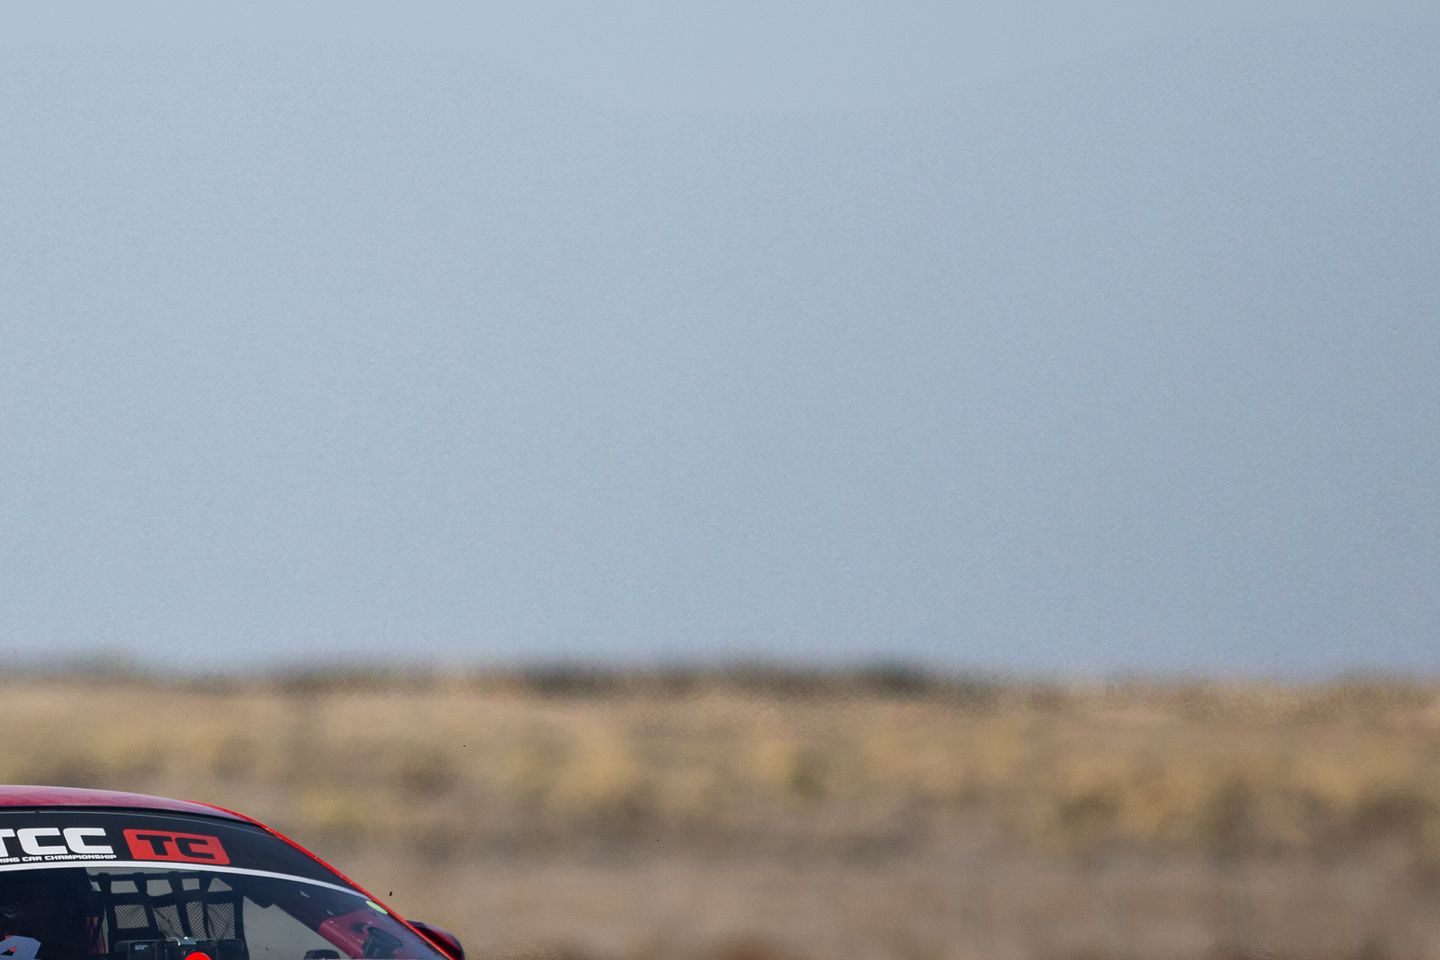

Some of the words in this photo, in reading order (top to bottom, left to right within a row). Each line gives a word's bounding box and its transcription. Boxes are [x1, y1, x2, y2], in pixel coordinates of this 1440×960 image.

[136, 834, 216, 859] TC
[22, 855, 42, 863] CAR
[44, 853, 117, 861] CHAMPIONSHIP
